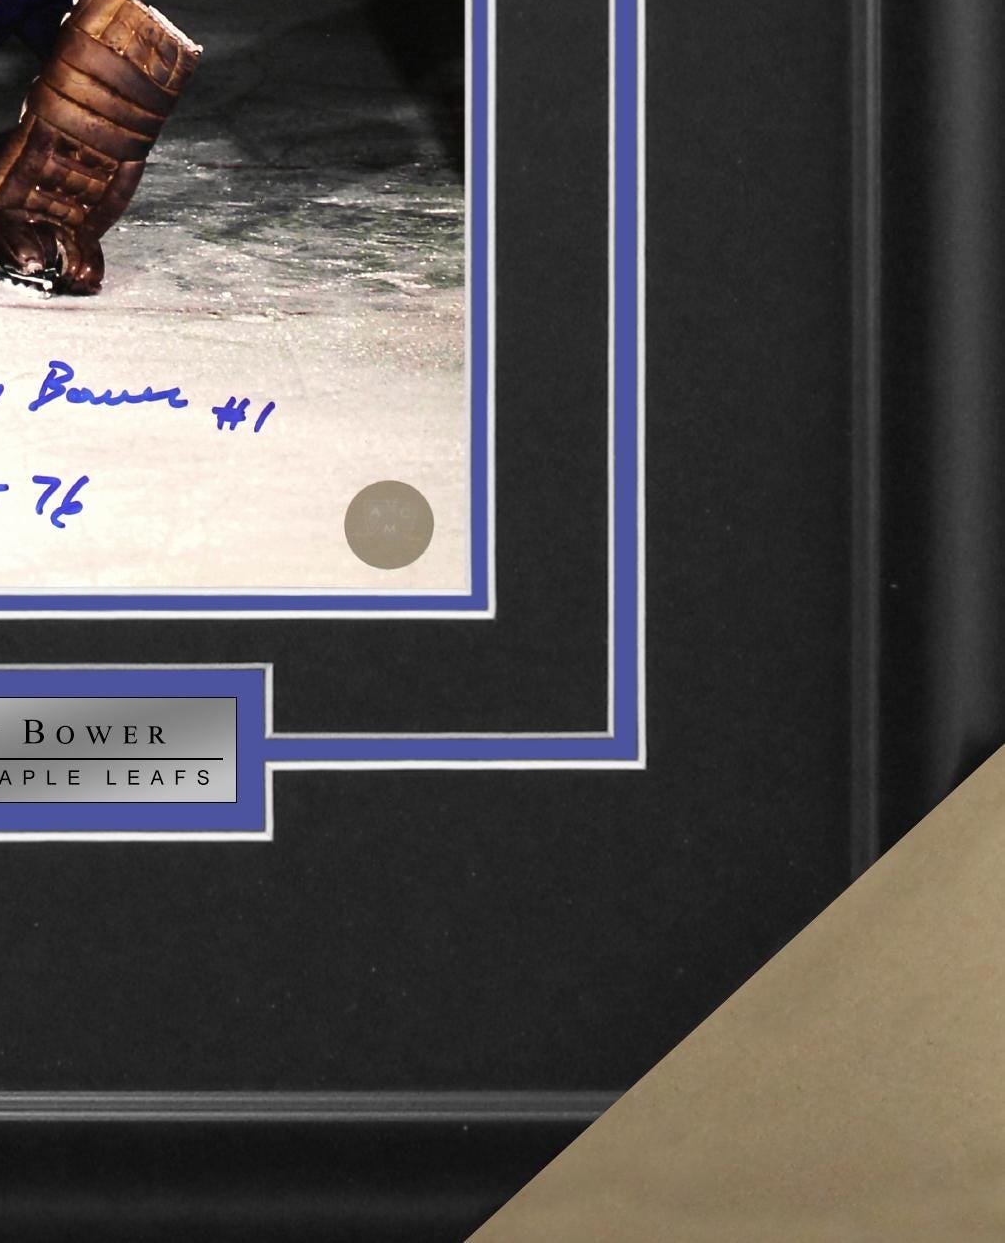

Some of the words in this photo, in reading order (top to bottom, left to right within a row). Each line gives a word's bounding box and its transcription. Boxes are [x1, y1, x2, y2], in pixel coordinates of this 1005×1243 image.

[212, 397, 276, 432] #1
[32, 474, 90, 529] 76
[106, 769, 211, 786] LEAFS
